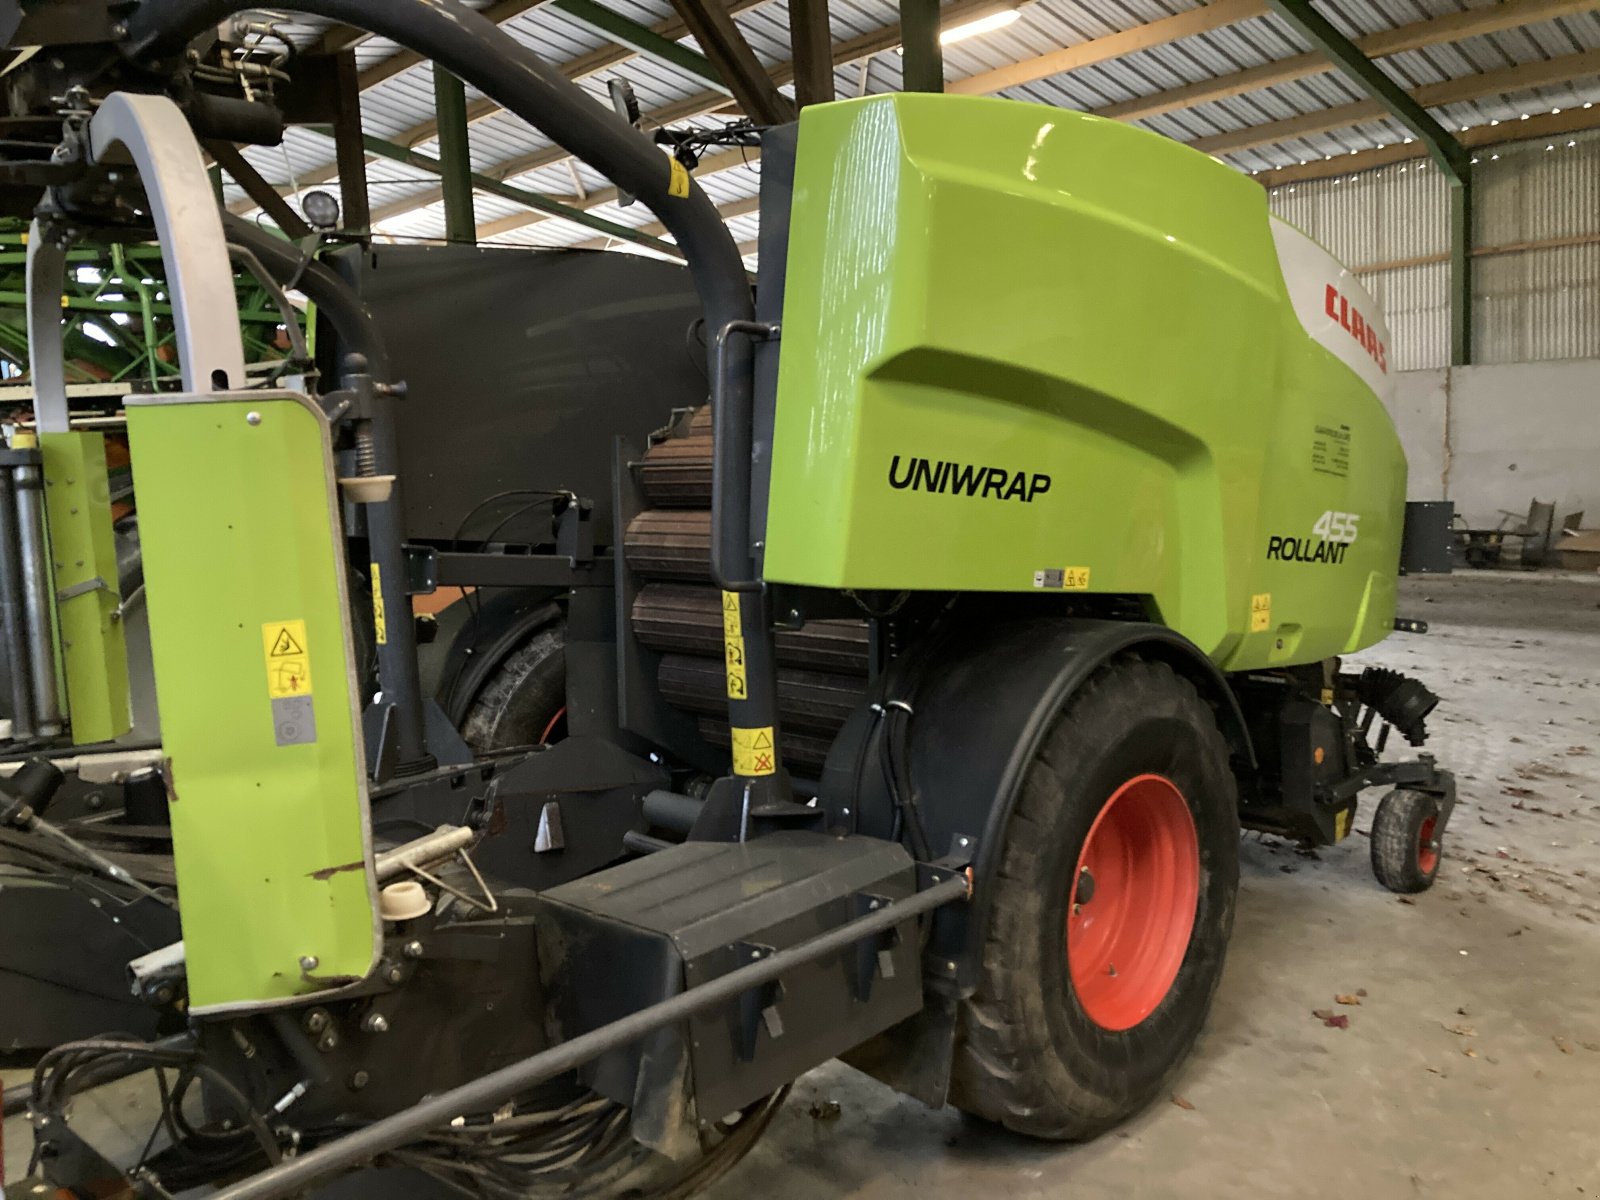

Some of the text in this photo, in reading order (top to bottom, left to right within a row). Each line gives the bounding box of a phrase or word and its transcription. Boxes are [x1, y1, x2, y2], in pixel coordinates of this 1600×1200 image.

[1325, 283, 1387, 375] CLAAS
[888, 455, 1052, 503] UNIWRAP
[1312, 510, 1360, 544] 455
[1266, 536, 1349, 564] ROLLANT
